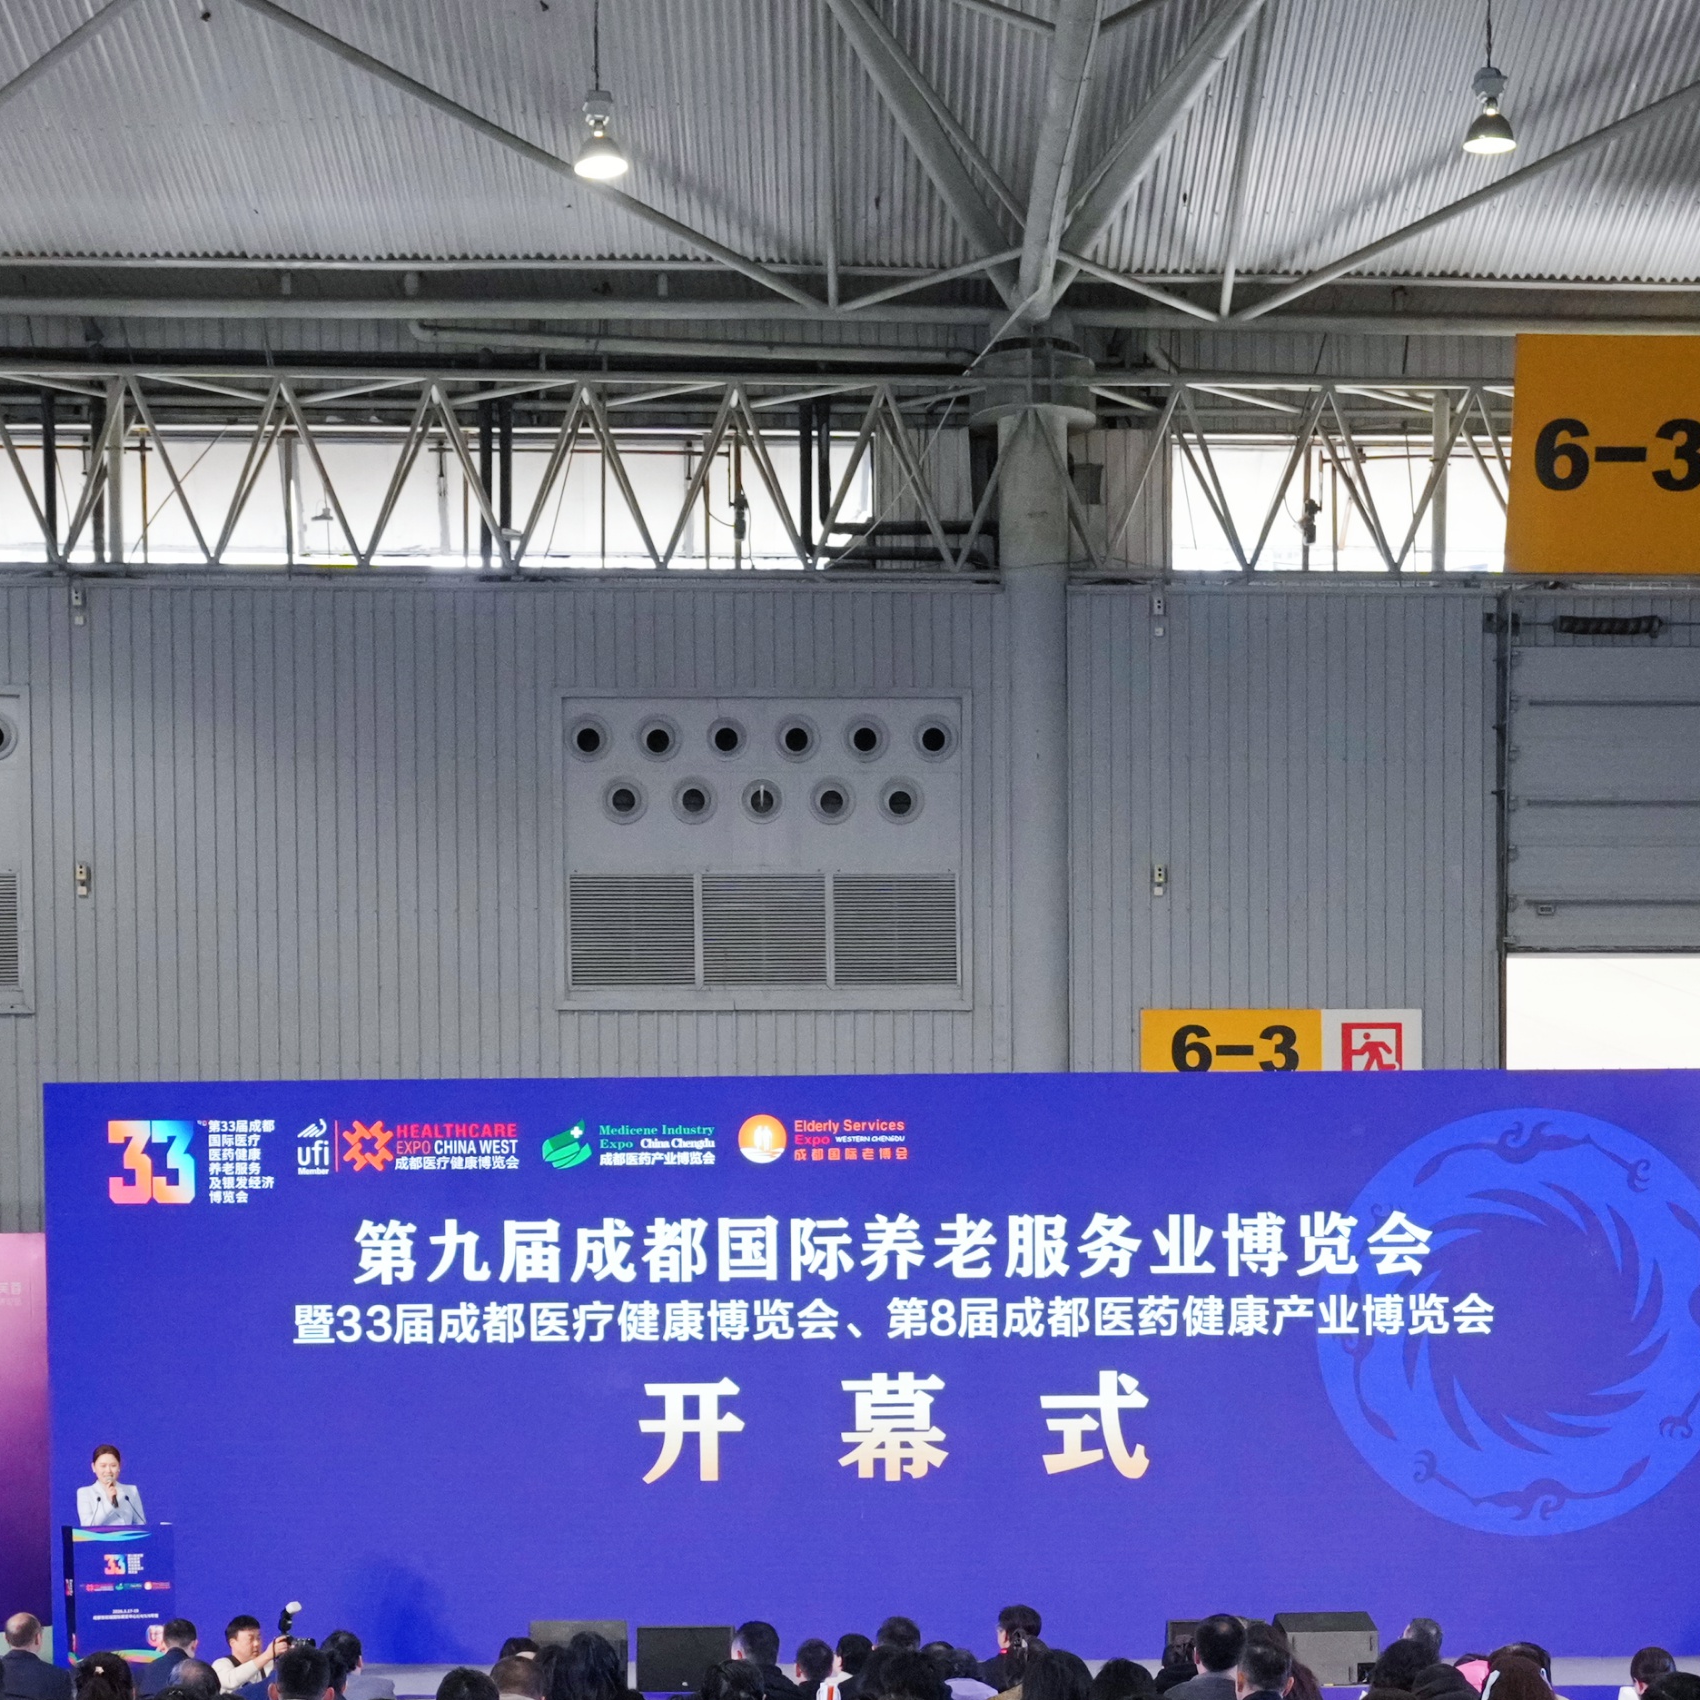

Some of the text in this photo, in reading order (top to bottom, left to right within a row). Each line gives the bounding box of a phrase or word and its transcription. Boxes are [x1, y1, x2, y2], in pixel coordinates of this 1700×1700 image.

[1171, 1024, 1299, 1072] 6-3
[208, 1119, 275, 1132] 第33届成都
[397, 1123, 518, 1139] HEALTHCARE
[599, 1124, 715, 1136] Medicene Industry
[794, 1119, 905, 1134] Elderly Services
[208, 1134, 261, 1147] 国际医疗
[396, 1139, 518, 1155] EXPO CHINA WEST
[600, 1138, 716, 1151] Expo China Chengdu
[795, 1134, 831, 1146] Expo
[208, 1148, 261, 1161] 医药健康
[298, 1140, 330, 1167] ufi
[599, 1151, 716, 1166] 成都医药产业博览会
[108, 1120, 195, 1204] 33
[208, 1162, 261, 1175] 养老服务
[395, 1156, 520, 1170] 成都医疗健康博览会
[298, 1167, 330, 1175] Member
[209, 1176, 275, 1189] 及银发经济
[209, 1190, 249, 1204] 博览会
[352, 1211, 1434, 1287] 第九届成都国际养老服务业博览会
[293, 1292, 1496, 1346] 暨33届成都医疗健康博览会、第8届成都医药健康产业博览会
[637, 1369, 1151, 1485] 开幕式
